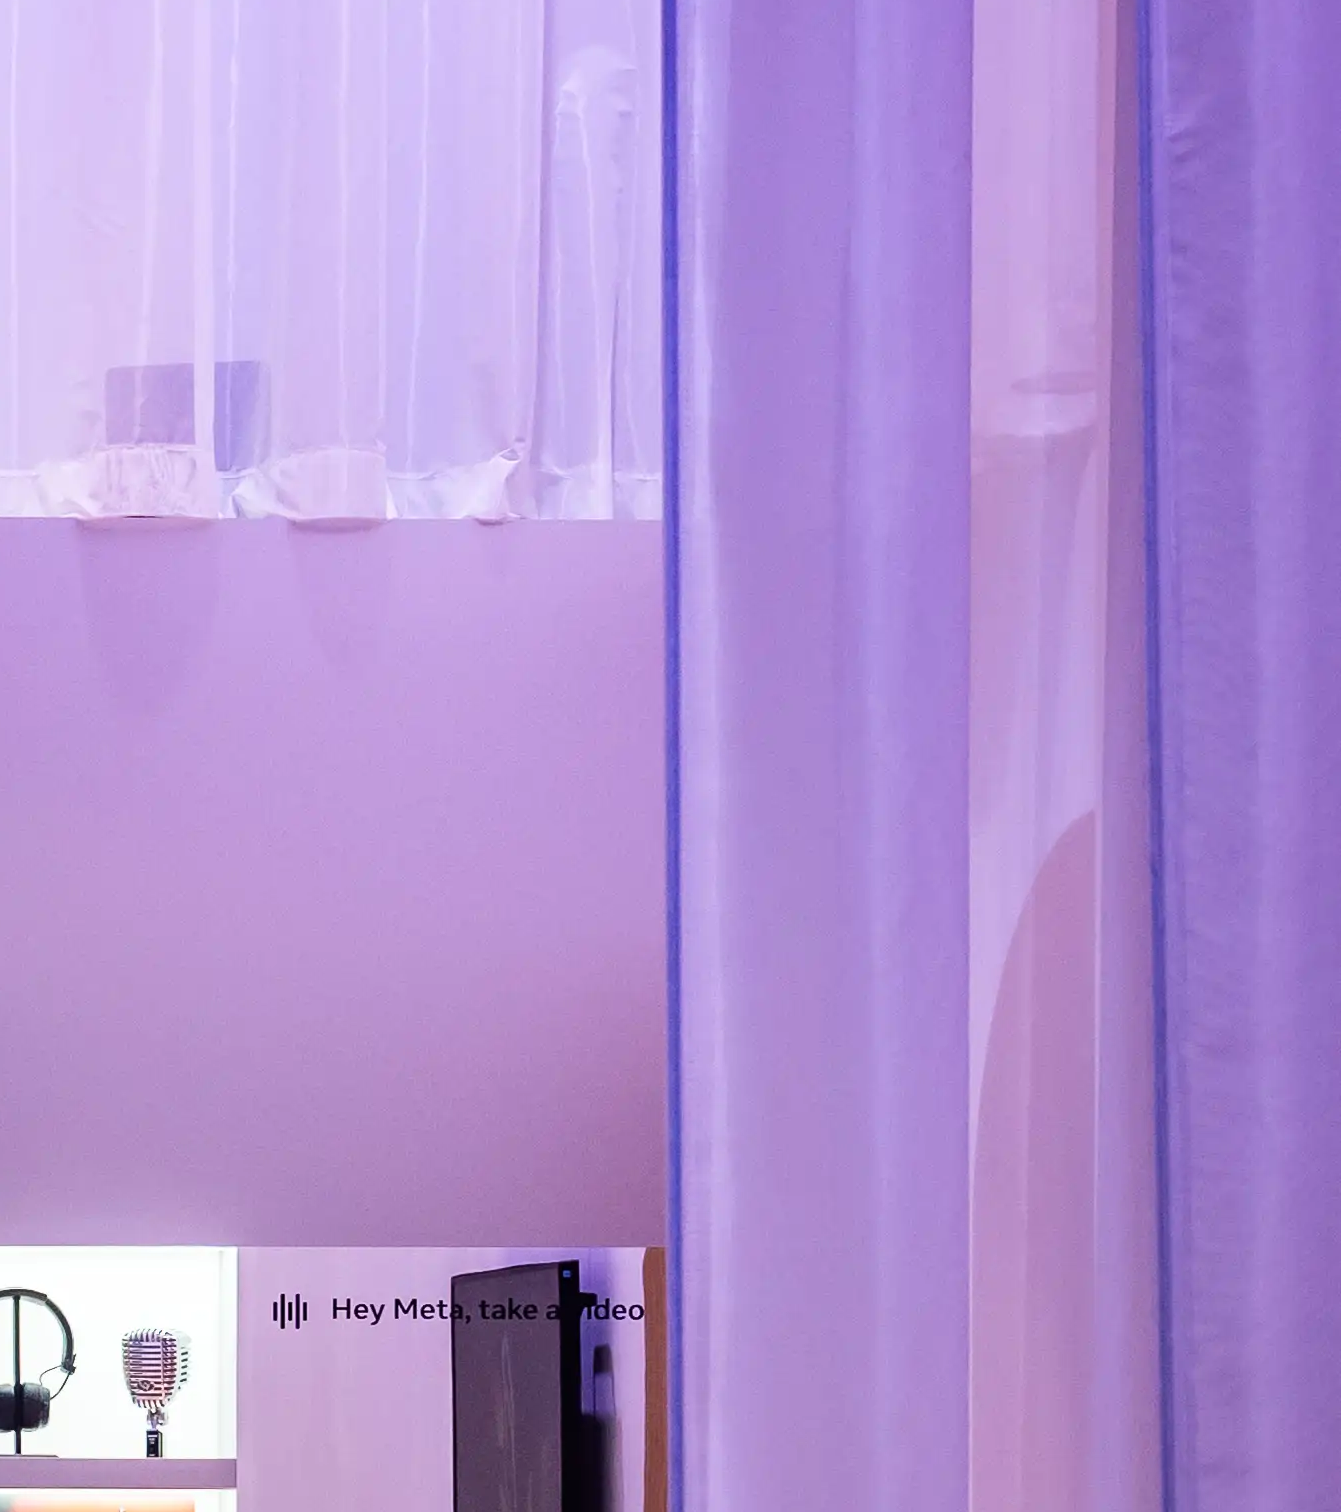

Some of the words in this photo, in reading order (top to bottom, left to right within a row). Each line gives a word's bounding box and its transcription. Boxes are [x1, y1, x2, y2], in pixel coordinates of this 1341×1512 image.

[332, 1298, 385, 1325] Hey
[394, 1298, 471, 1324] Meta,
[479, 1297, 538, 1320] take
[546, 1303, 561, 1320] a
